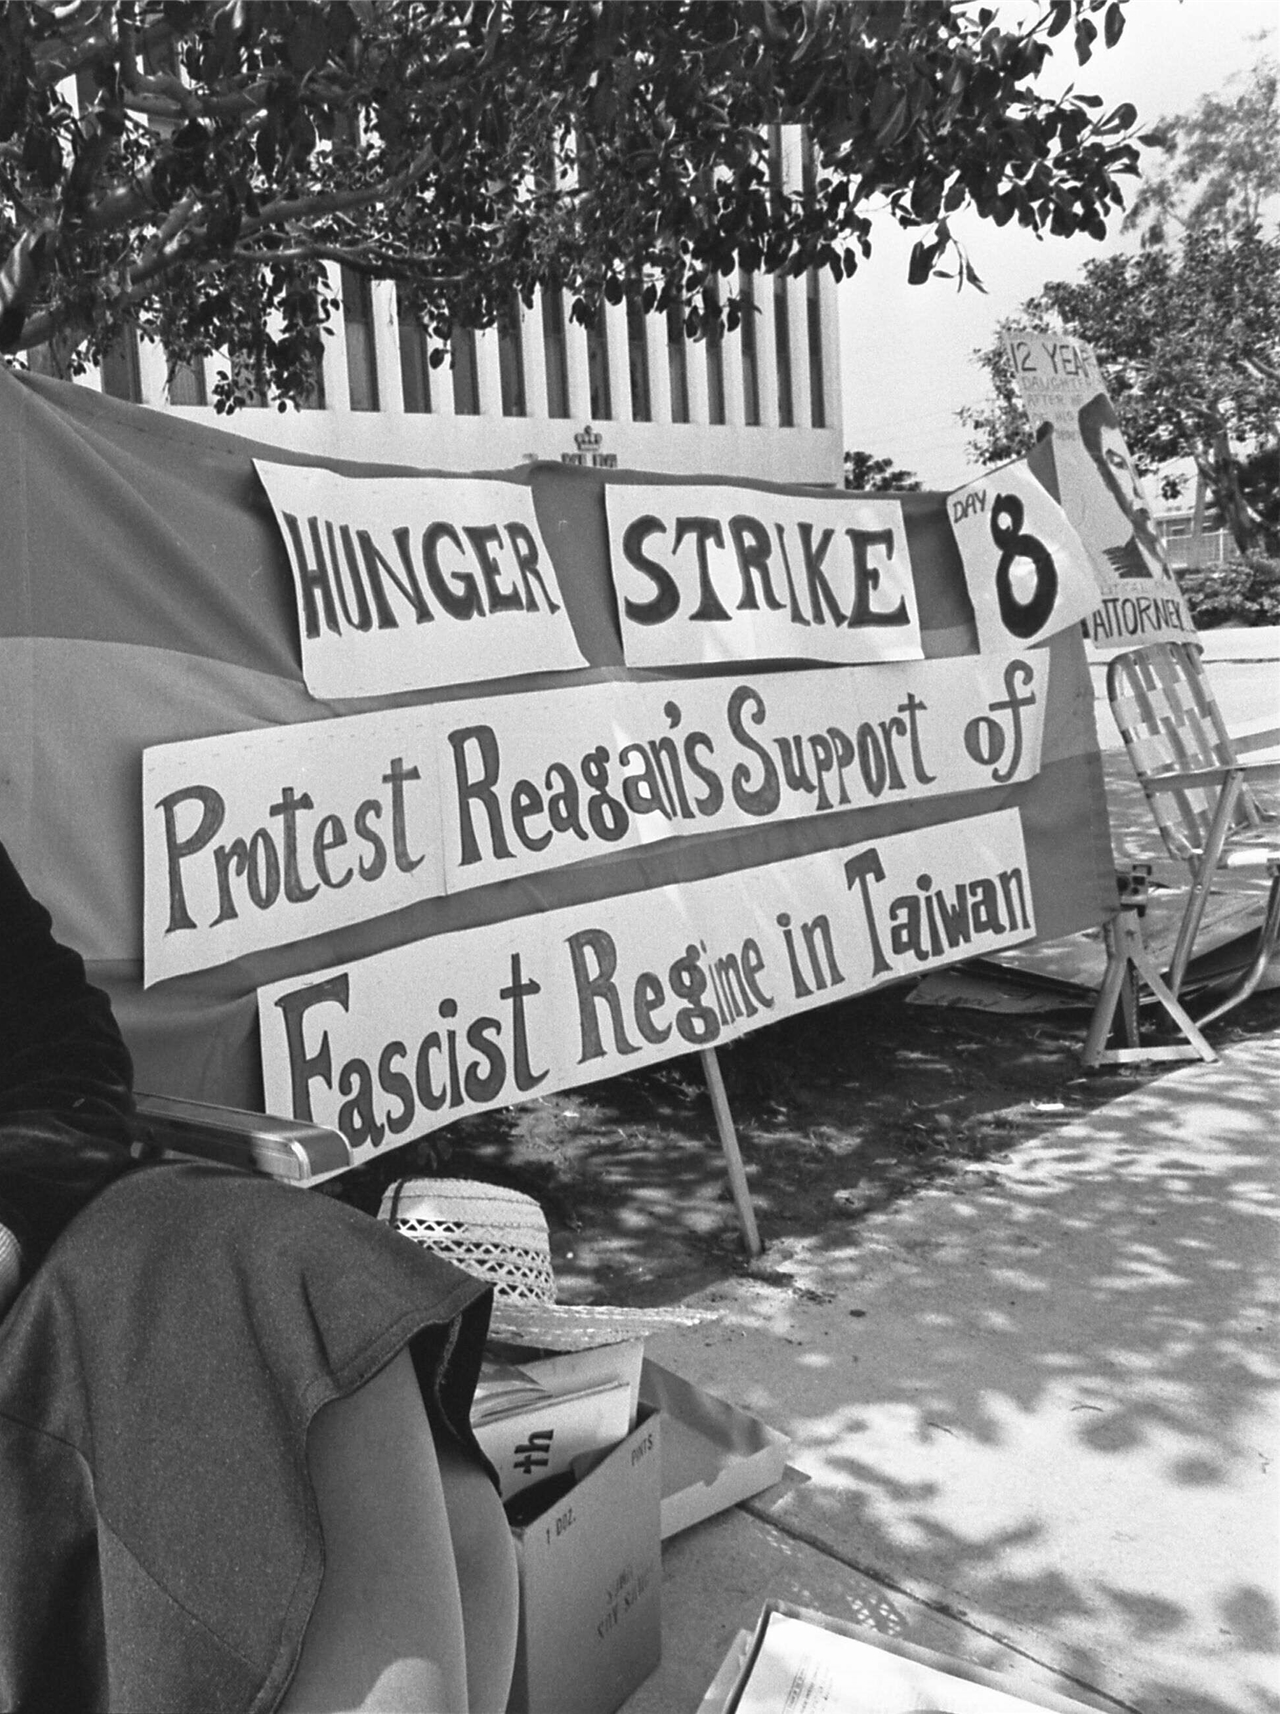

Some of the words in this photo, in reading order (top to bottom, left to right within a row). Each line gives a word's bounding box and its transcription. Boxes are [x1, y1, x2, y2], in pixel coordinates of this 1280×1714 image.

[1010, 341, 1038, 374] 12
[953, 490, 989, 524] DAY
[990, 493, 1058, 639] 8
[281, 510, 561, 640] HUNGER
[622, 514, 910, 629] STRIKE
[1093, 596, 1185, 641] ATTORNEY
[154, 757, 426, 938] Protest
[448, 701, 725, 867] Reagan's
[726, 685, 938, 817] Support
[964, 659, 1037, 784] of
[274, 953, 551, 1149] Fascist
[564, 929, 775, 1066] Regime
[776, 912, 846, 1000] in
[844, 847, 1031, 977] Taiwan
